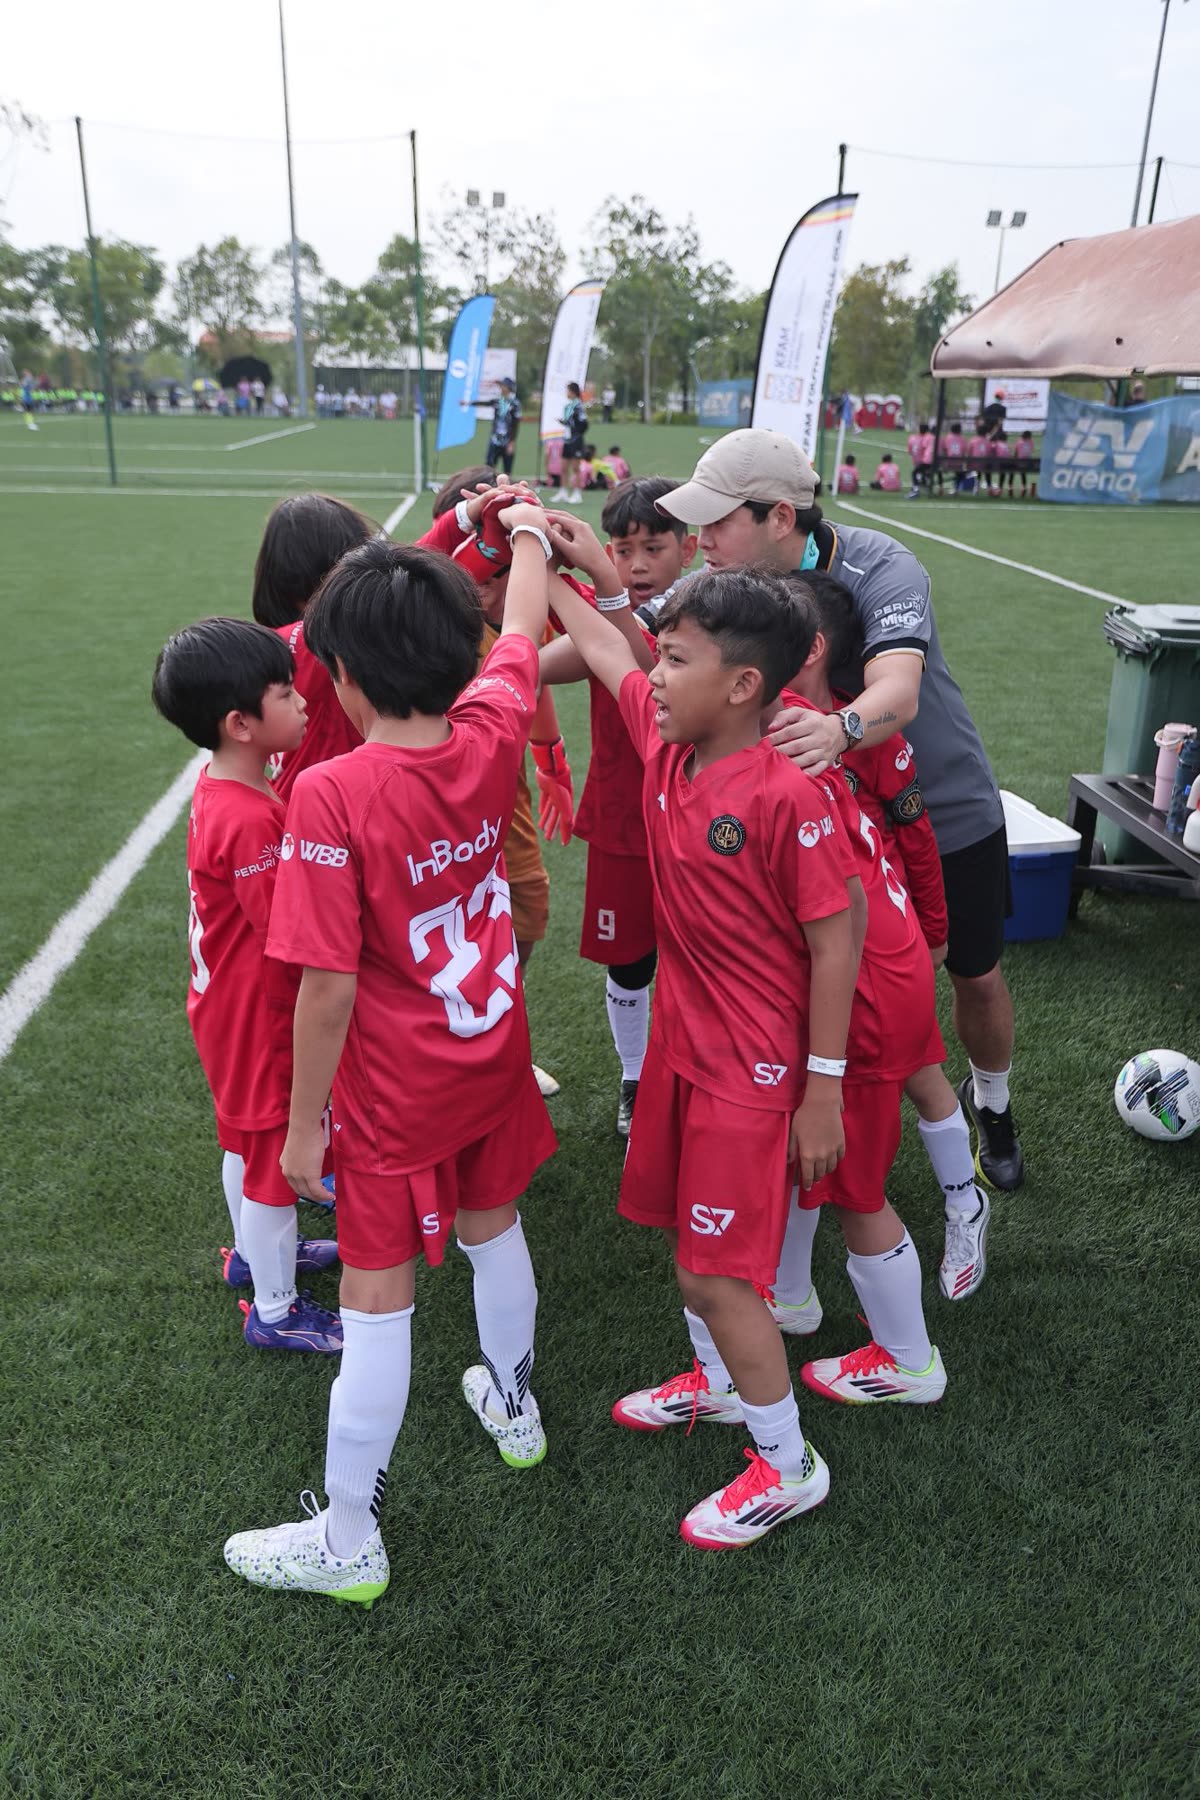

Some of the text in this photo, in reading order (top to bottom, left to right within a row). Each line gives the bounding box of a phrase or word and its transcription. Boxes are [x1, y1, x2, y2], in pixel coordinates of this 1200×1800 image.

[1052, 468, 1137, 491] arena
[406, 815, 502, 886] InBody
[234, 857, 275, 879] PERURI
[597, 908, 615, 941] 9
[753, 1062, 788, 1086] S7
[689, 1203, 735, 1237] S7
